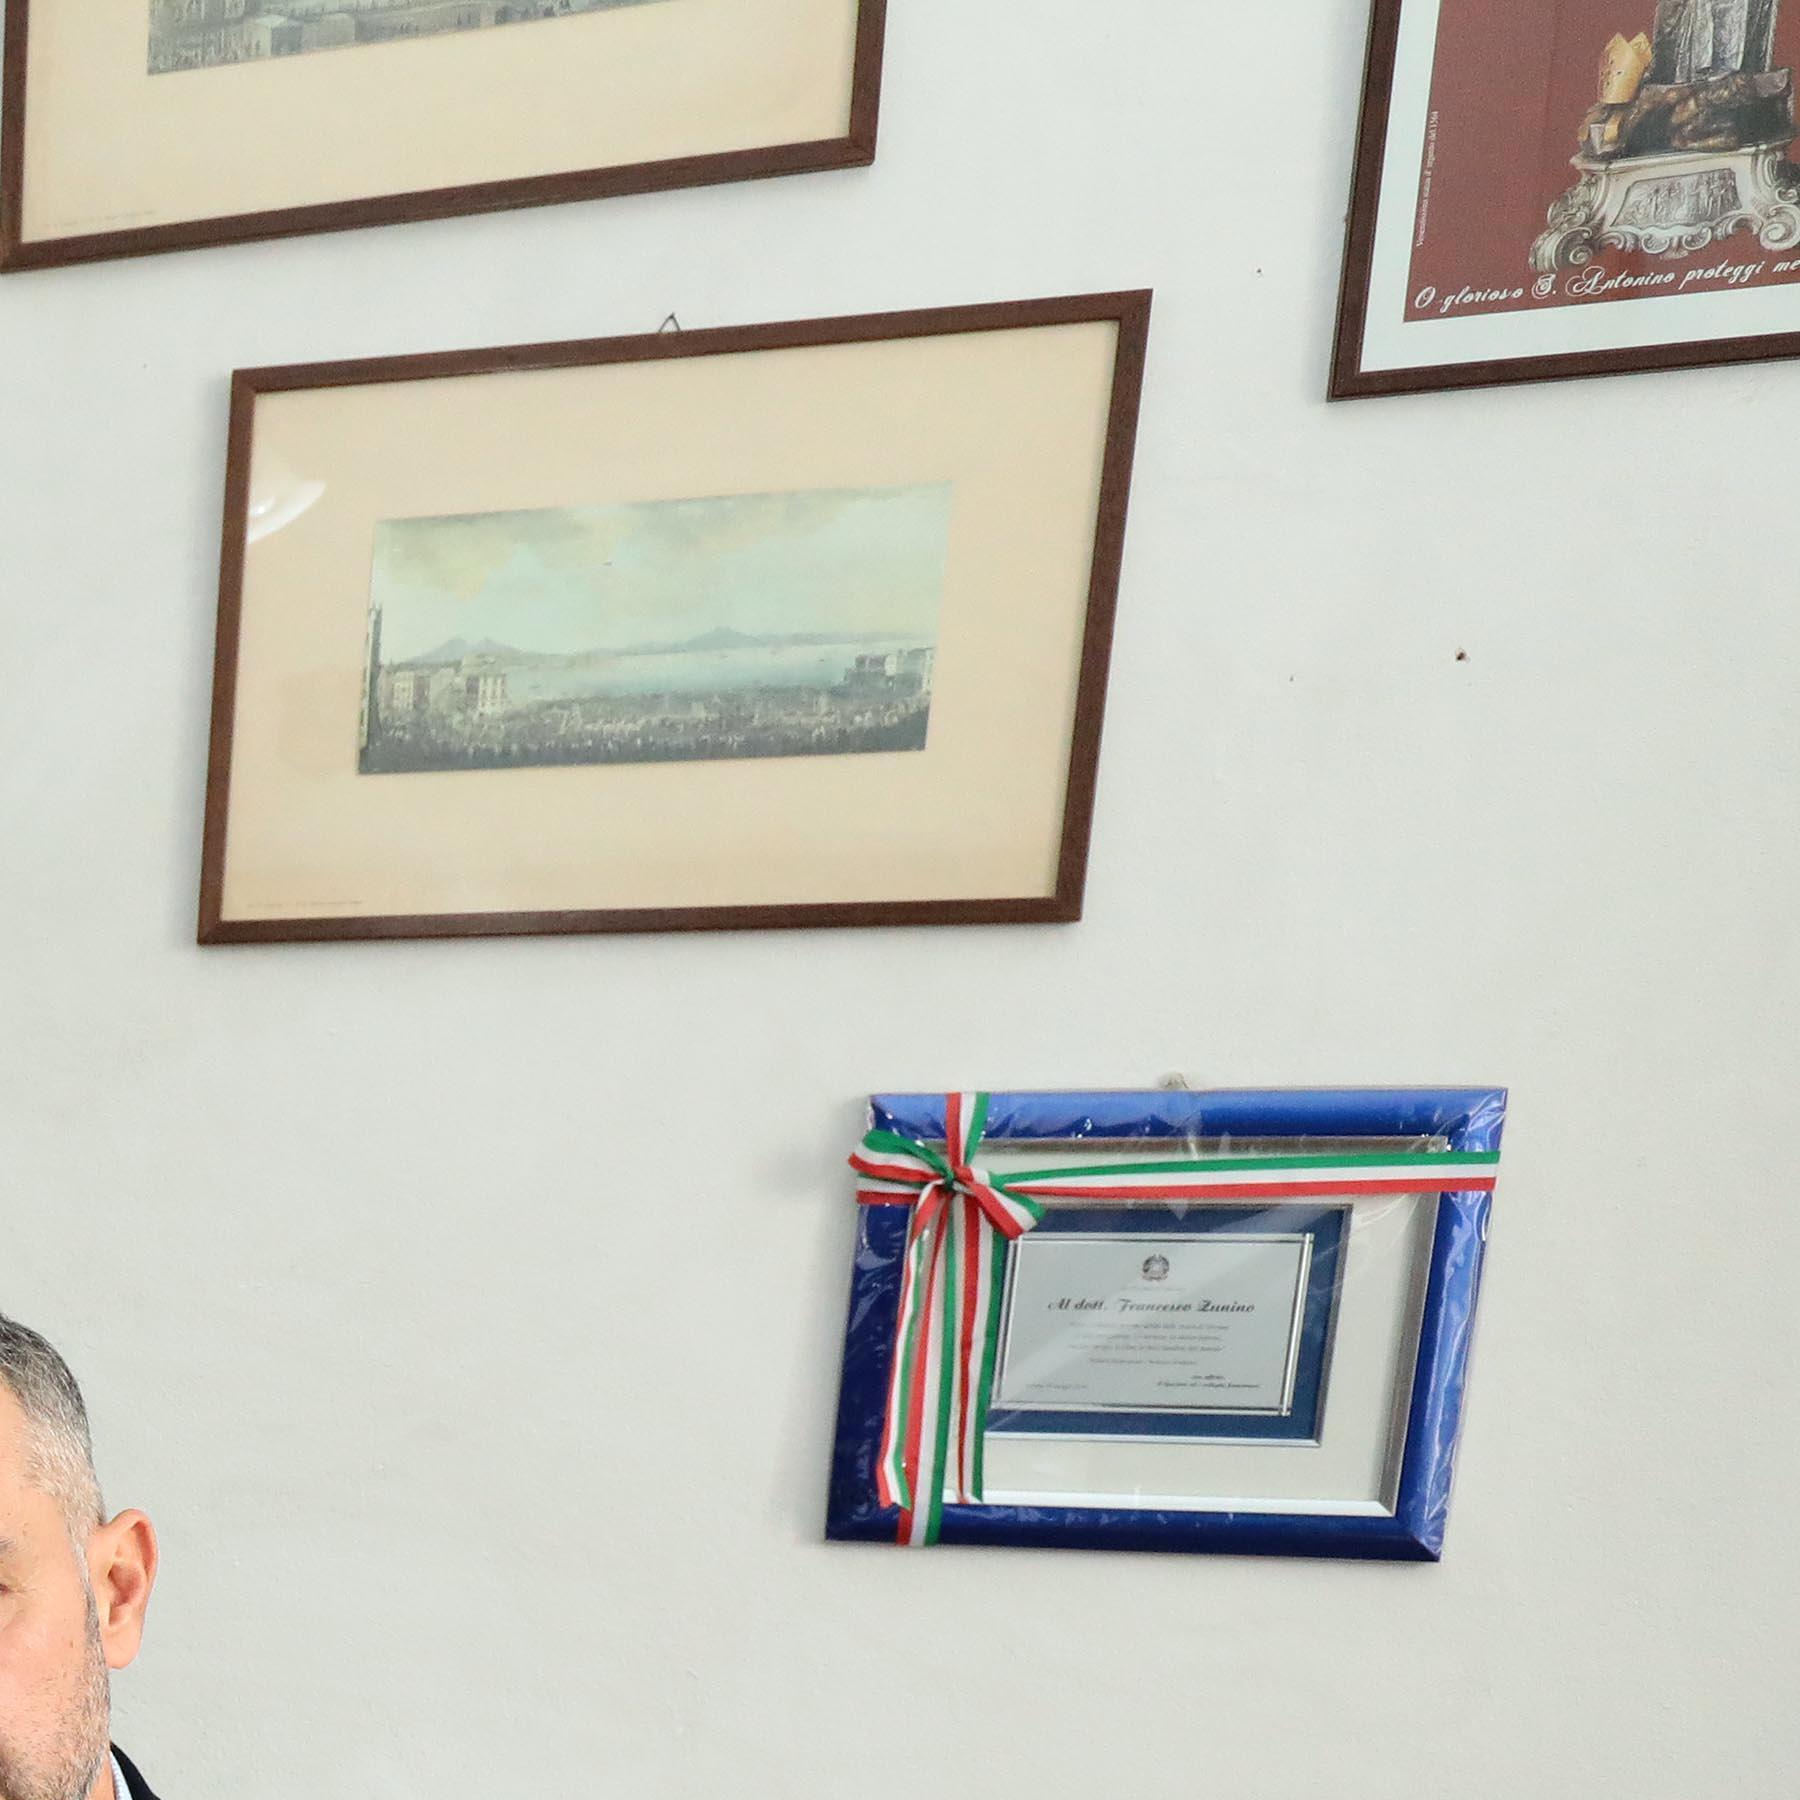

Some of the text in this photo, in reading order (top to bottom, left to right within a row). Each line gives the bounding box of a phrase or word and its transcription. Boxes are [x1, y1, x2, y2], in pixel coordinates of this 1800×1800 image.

[1414, 286, 1436, 309] O
[1440, 286, 1523, 314] glorioso
[1565, 265, 1675, 298] Antonino
[1678, 260, 1767, 290] proteggi
[1119, 1298, 1193, 1313] Francesco
[1197, 1298, 1256, 1313] Zunino
